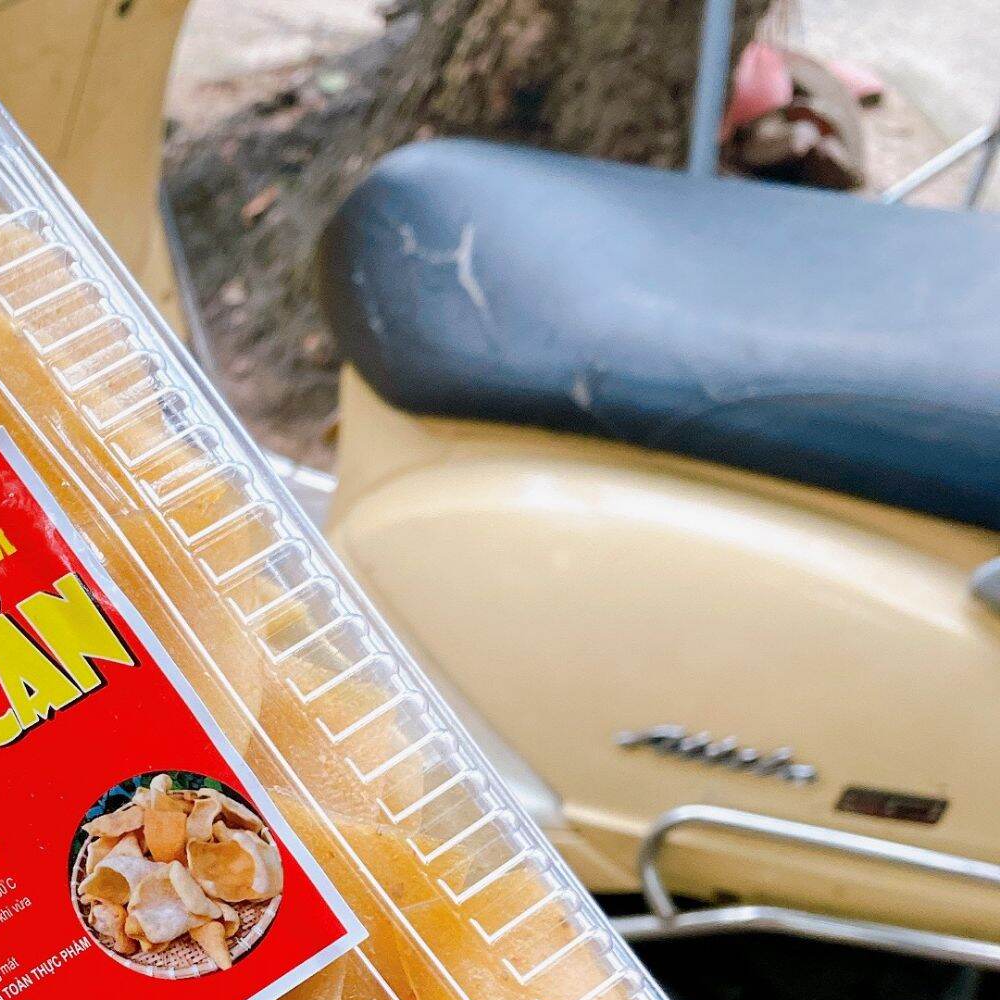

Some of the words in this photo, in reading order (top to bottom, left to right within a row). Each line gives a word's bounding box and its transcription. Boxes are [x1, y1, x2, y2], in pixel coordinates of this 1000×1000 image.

[12, 897, 32, 912] vừa
[0, 956, 19, 974] mát
[1, 974, 33, 998] TOÀN
[30, 955, 62, 980] THỰC
